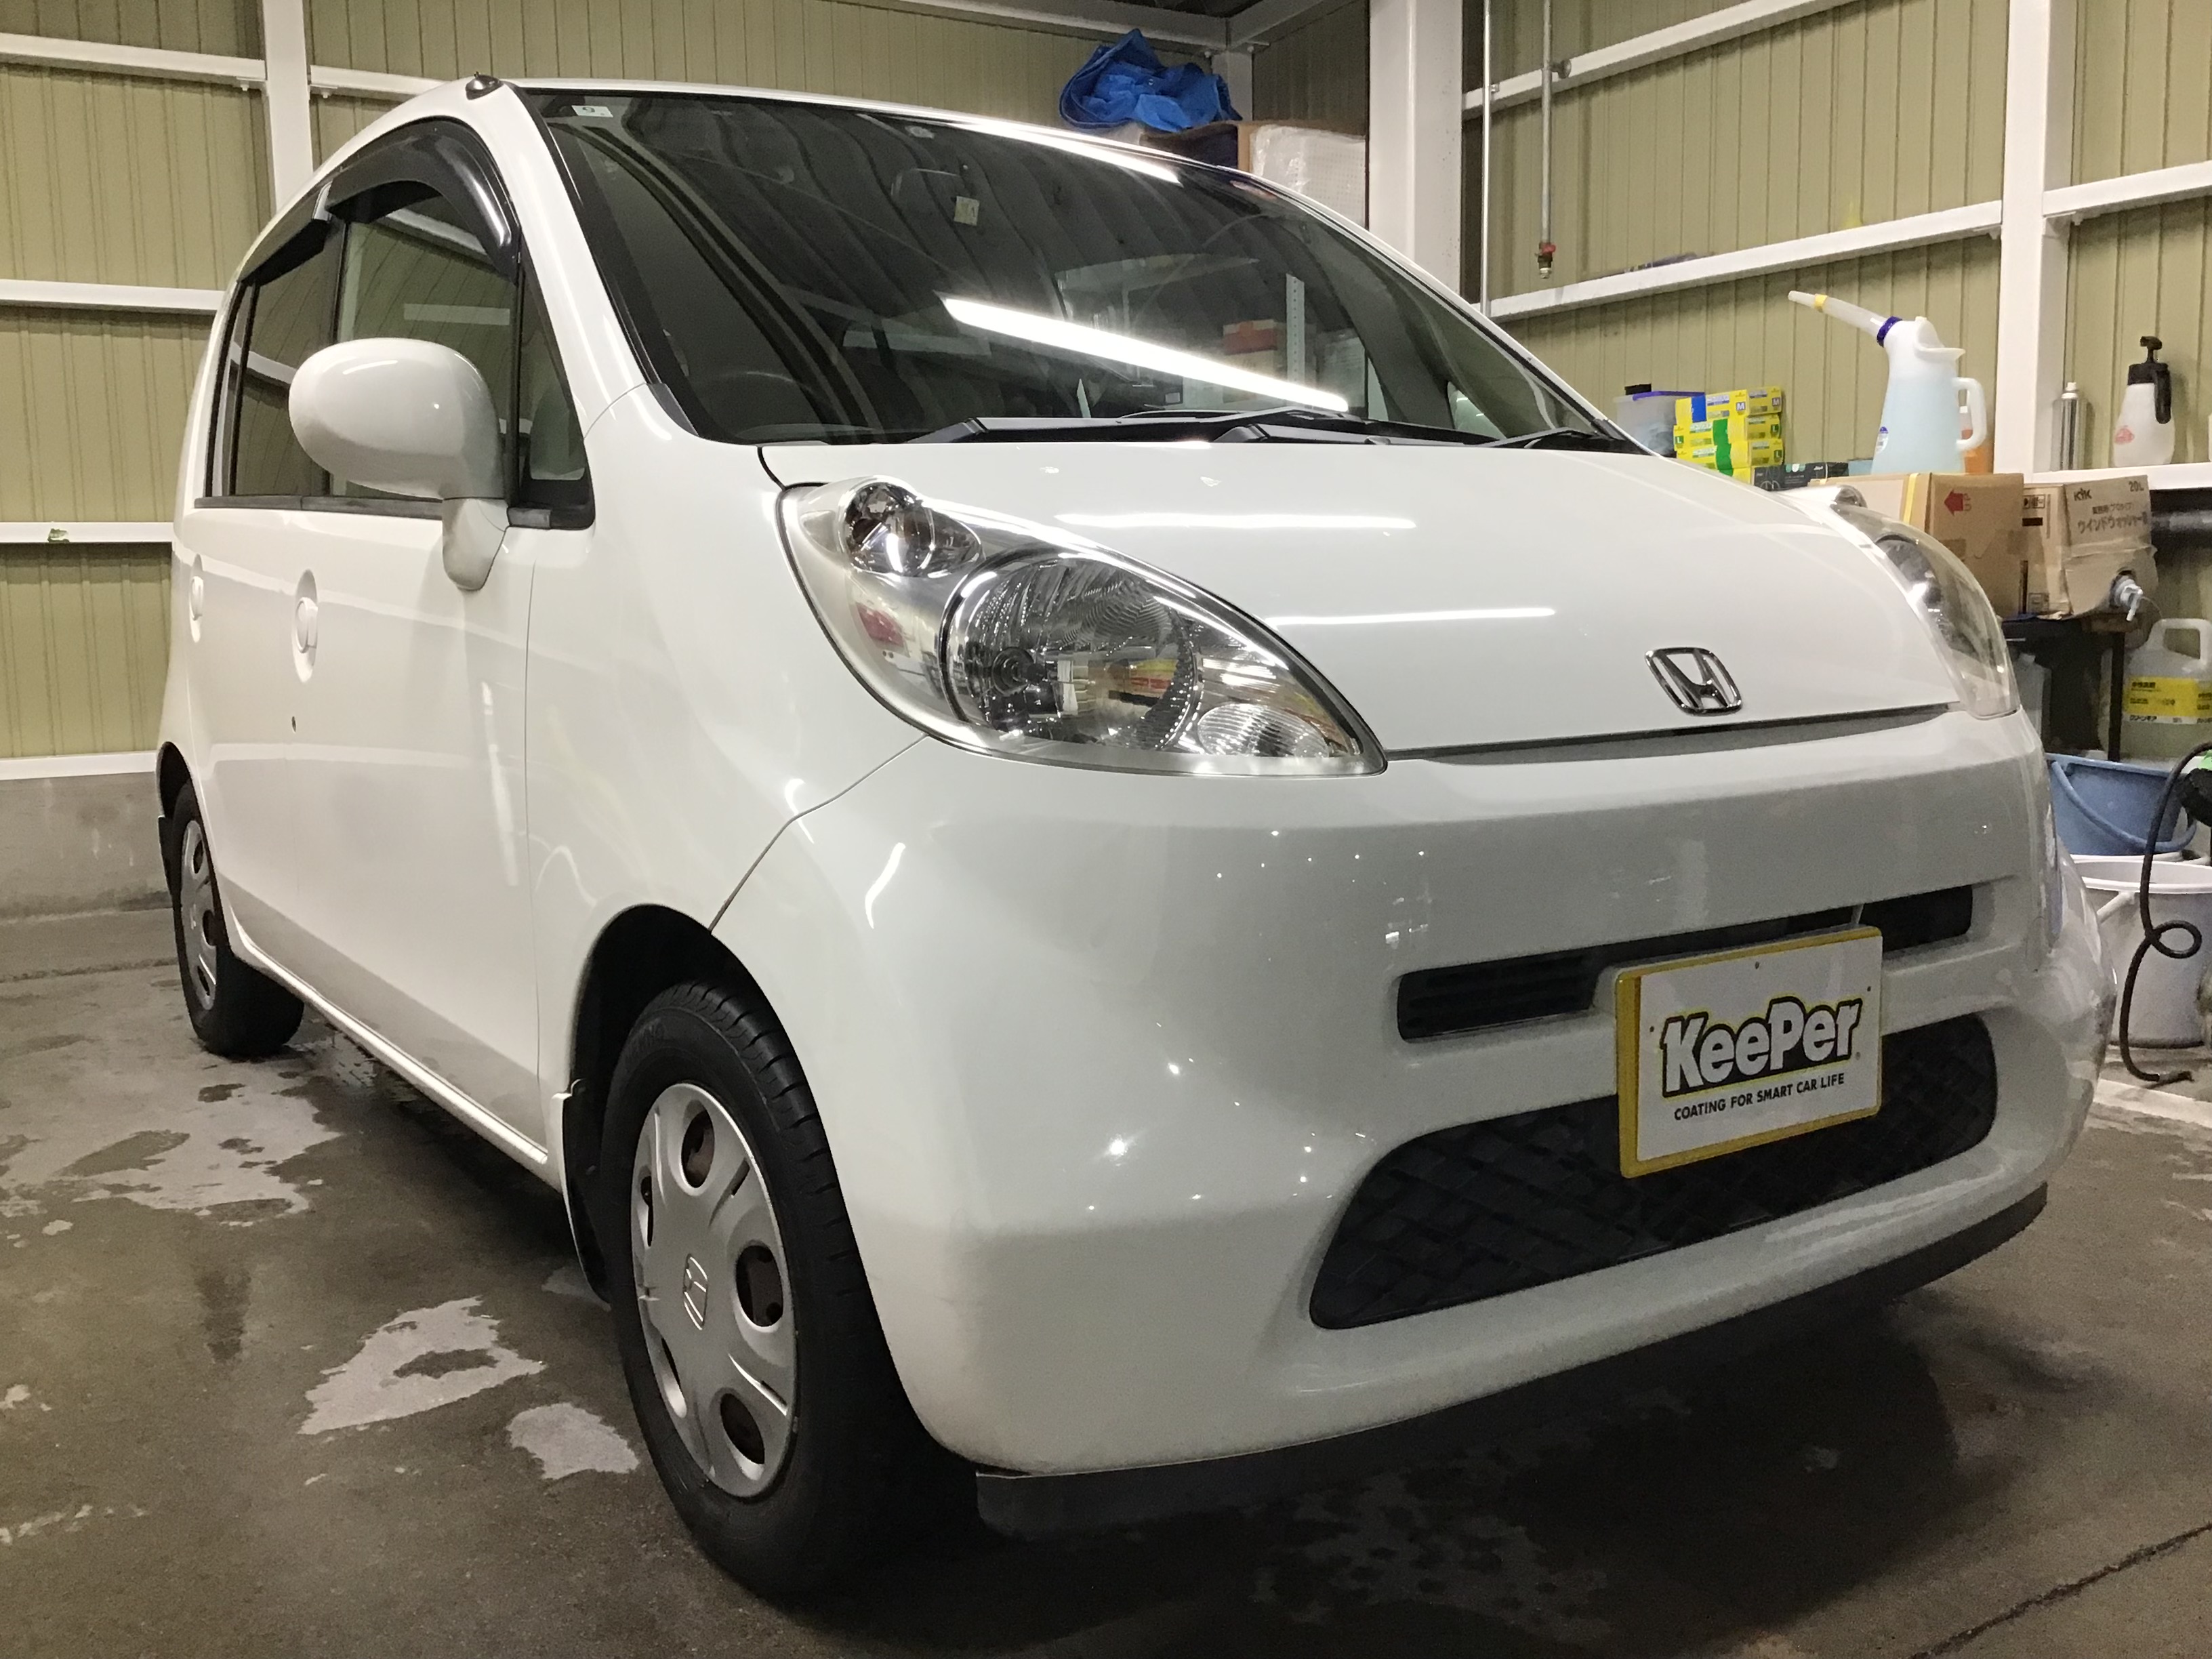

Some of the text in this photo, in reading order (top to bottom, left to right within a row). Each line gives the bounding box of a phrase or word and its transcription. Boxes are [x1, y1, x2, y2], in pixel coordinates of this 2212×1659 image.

[1660, 996, 1862, 1097] KeePer
[1674, 1073, 1845, 1120] COATING FOR SMART CAR LIFE
